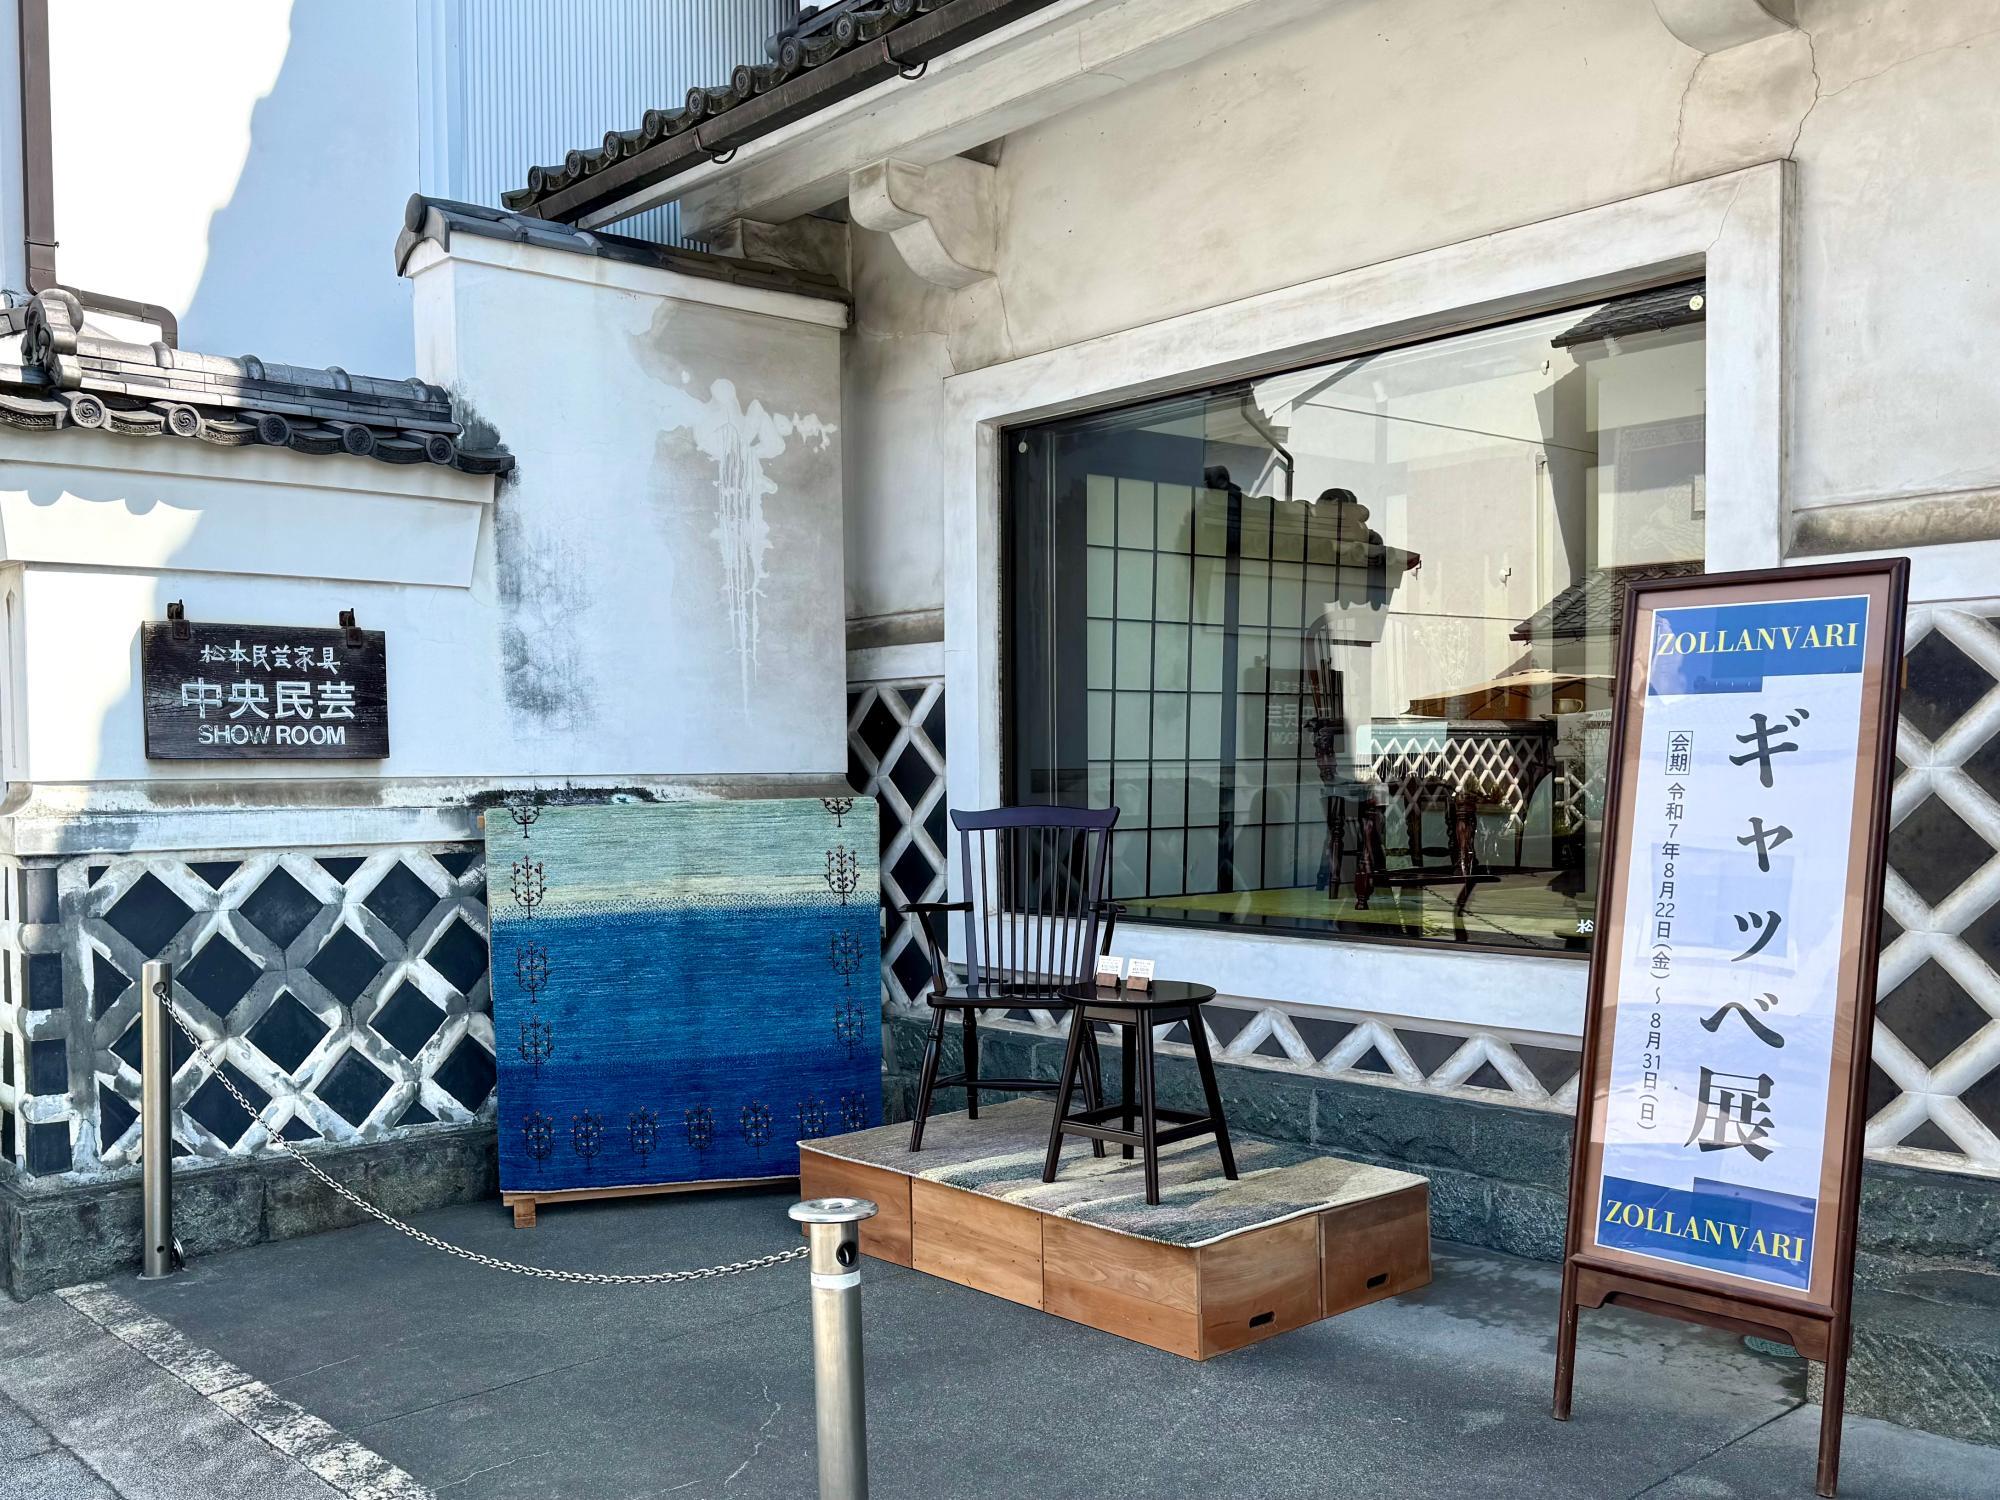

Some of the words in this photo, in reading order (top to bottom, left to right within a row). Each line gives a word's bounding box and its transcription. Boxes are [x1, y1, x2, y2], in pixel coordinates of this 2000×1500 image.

[200, 640, 341, 675] 松本民芸家具
[1657, 622, 1858, 656] ZOLLANVARI
[181, 678, 355, 719] 中央民芸
[199, 725, 270, 744] SHOW
[276, 726, 346, 744] ROOM
[1667, 732, 1691, 773] 会期
[1684, 708, 1810, 1162] ギャッベ展
[1605, 1199, 1807, 1263] ZOLLANVARI
